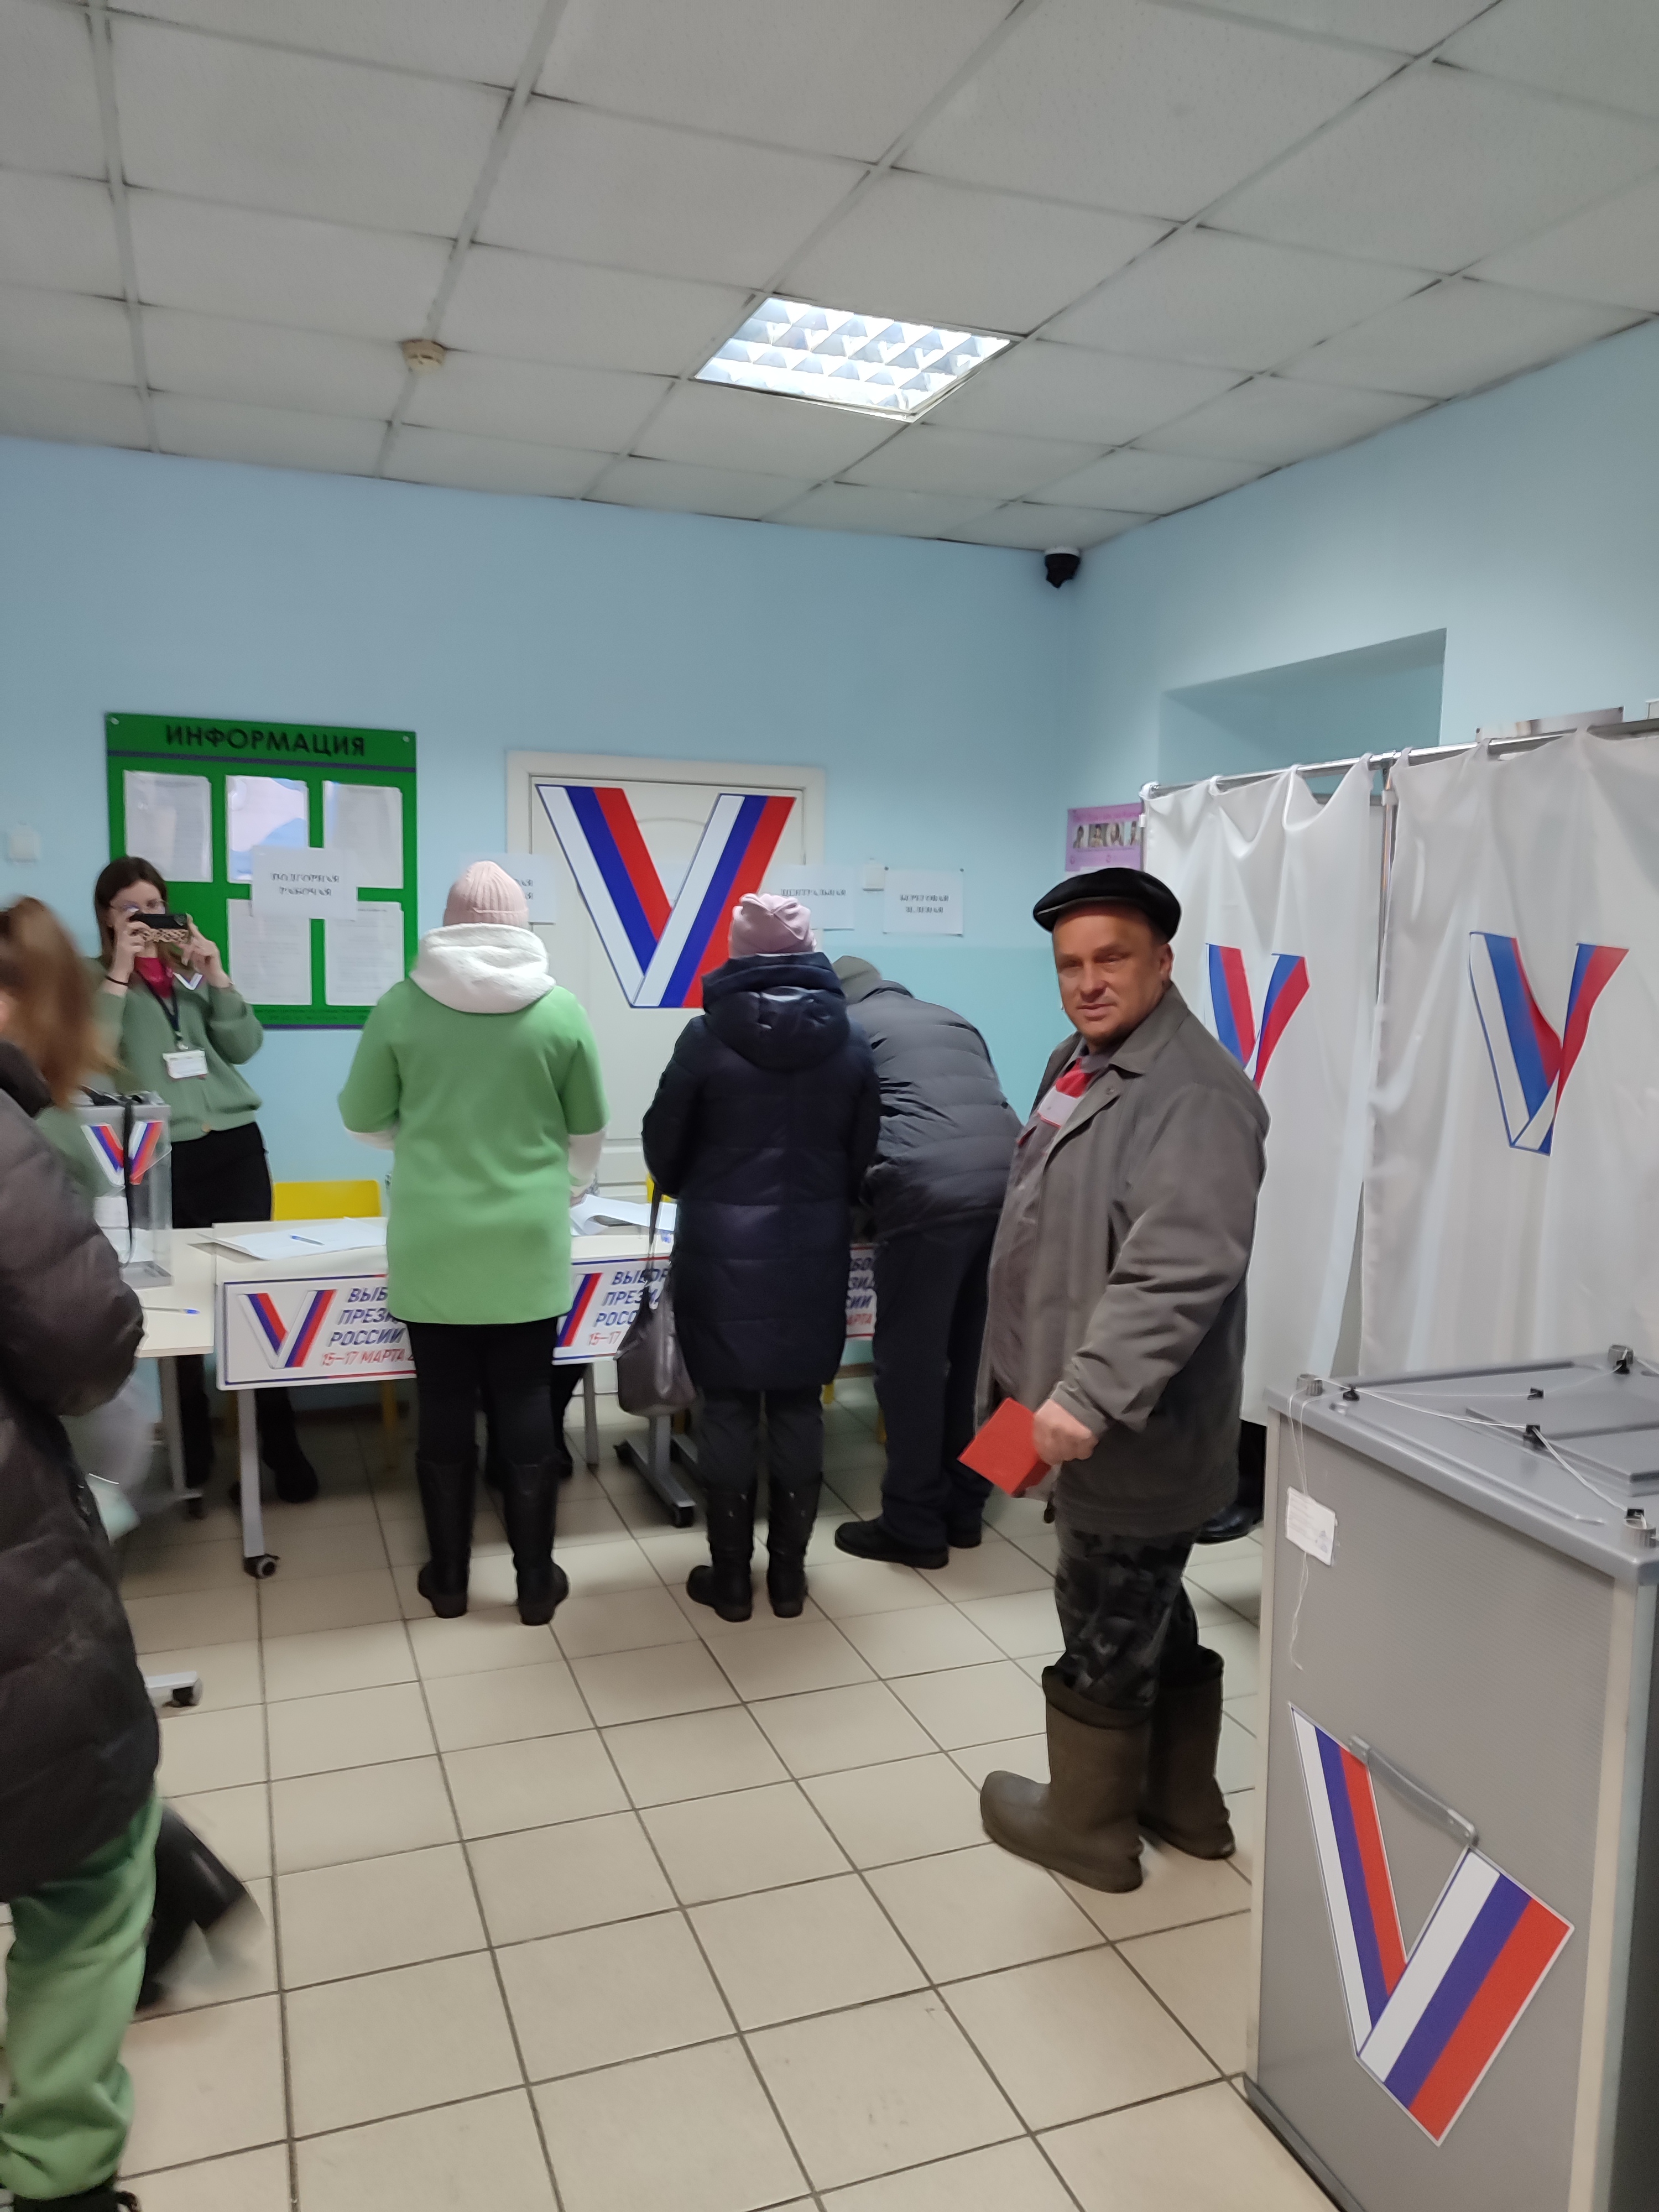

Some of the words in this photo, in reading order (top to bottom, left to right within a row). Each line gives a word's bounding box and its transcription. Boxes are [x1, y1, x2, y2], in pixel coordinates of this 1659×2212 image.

[166, 724, 366, 757] ИНФОРМАЦИЯ
[327, 1328, 405, 1347] РОССИИ
[361, 1348, 405, 1364] МАРТА
